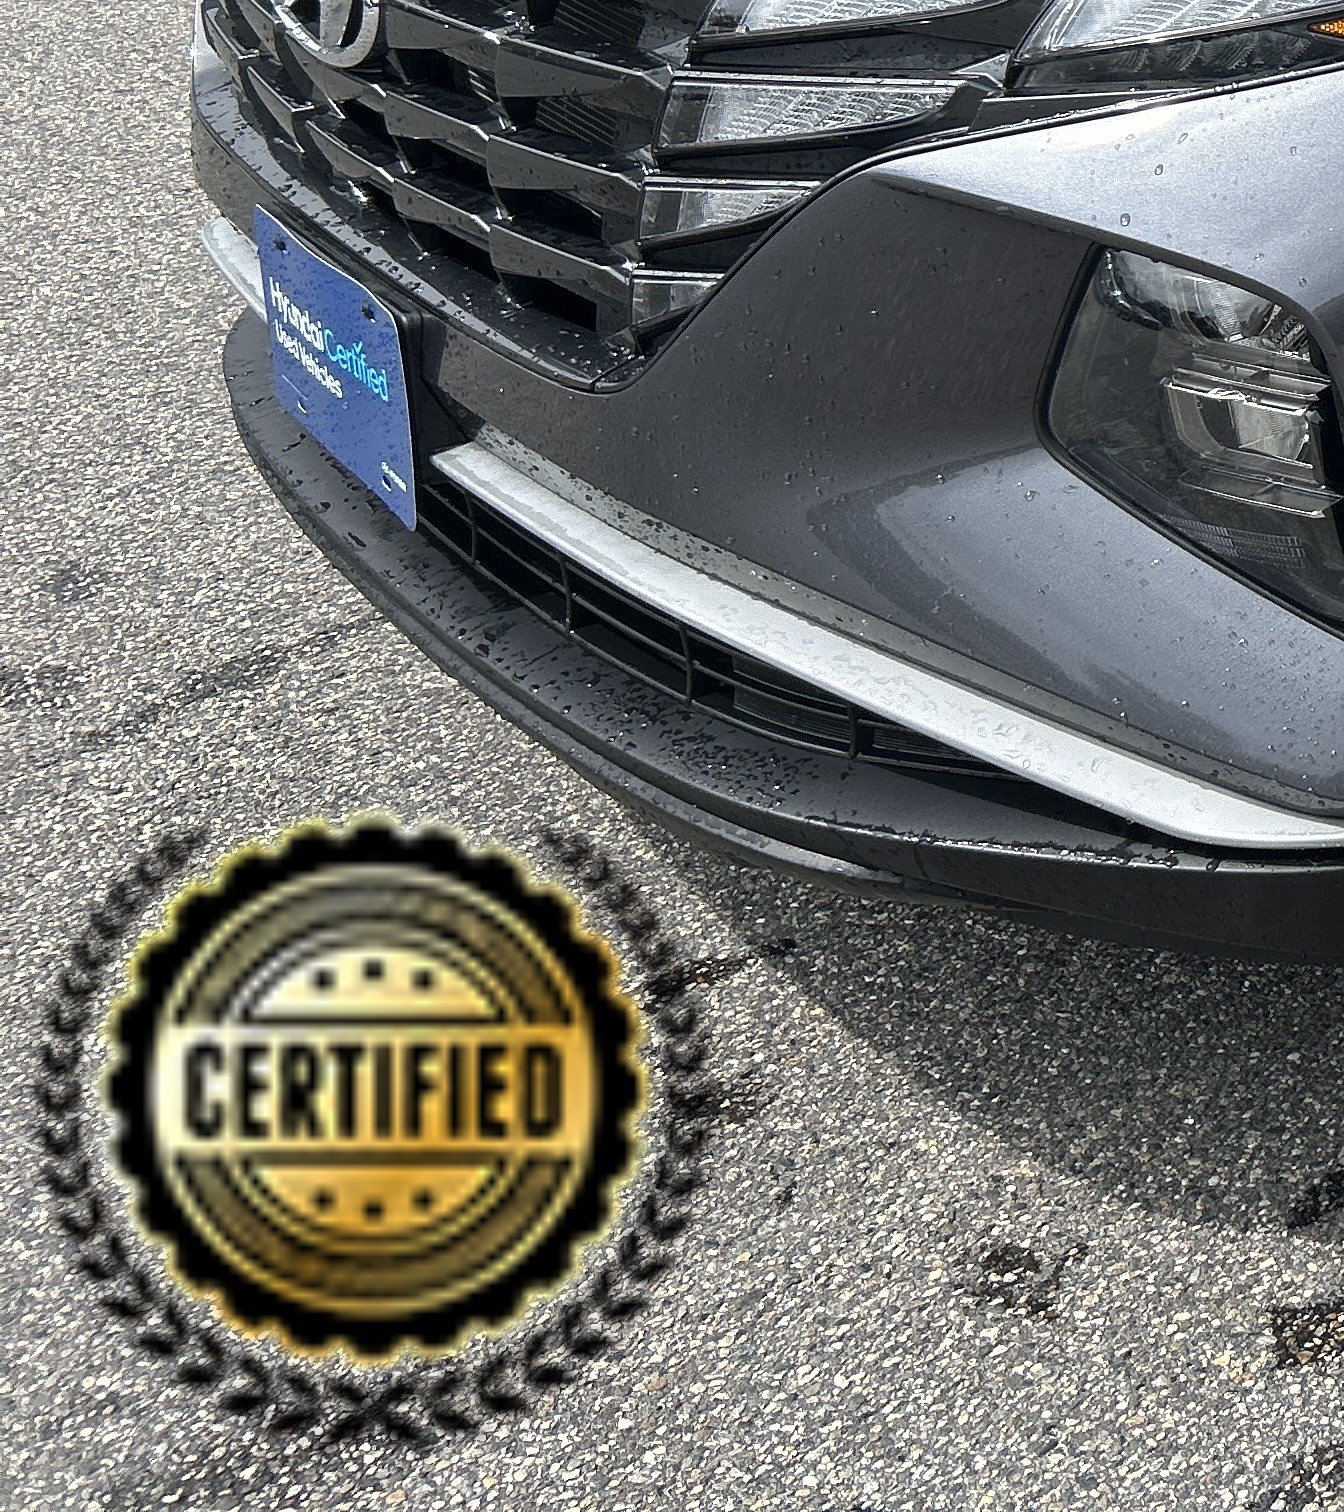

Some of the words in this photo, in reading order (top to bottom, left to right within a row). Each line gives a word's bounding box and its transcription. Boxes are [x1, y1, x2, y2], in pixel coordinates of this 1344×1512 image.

[269, 276, 325, 352] Hyundai
[323, 328, 389, 402] Certified
[274, 318, 300, 361] Used
[297, 341, 343, 399] Vehicles
